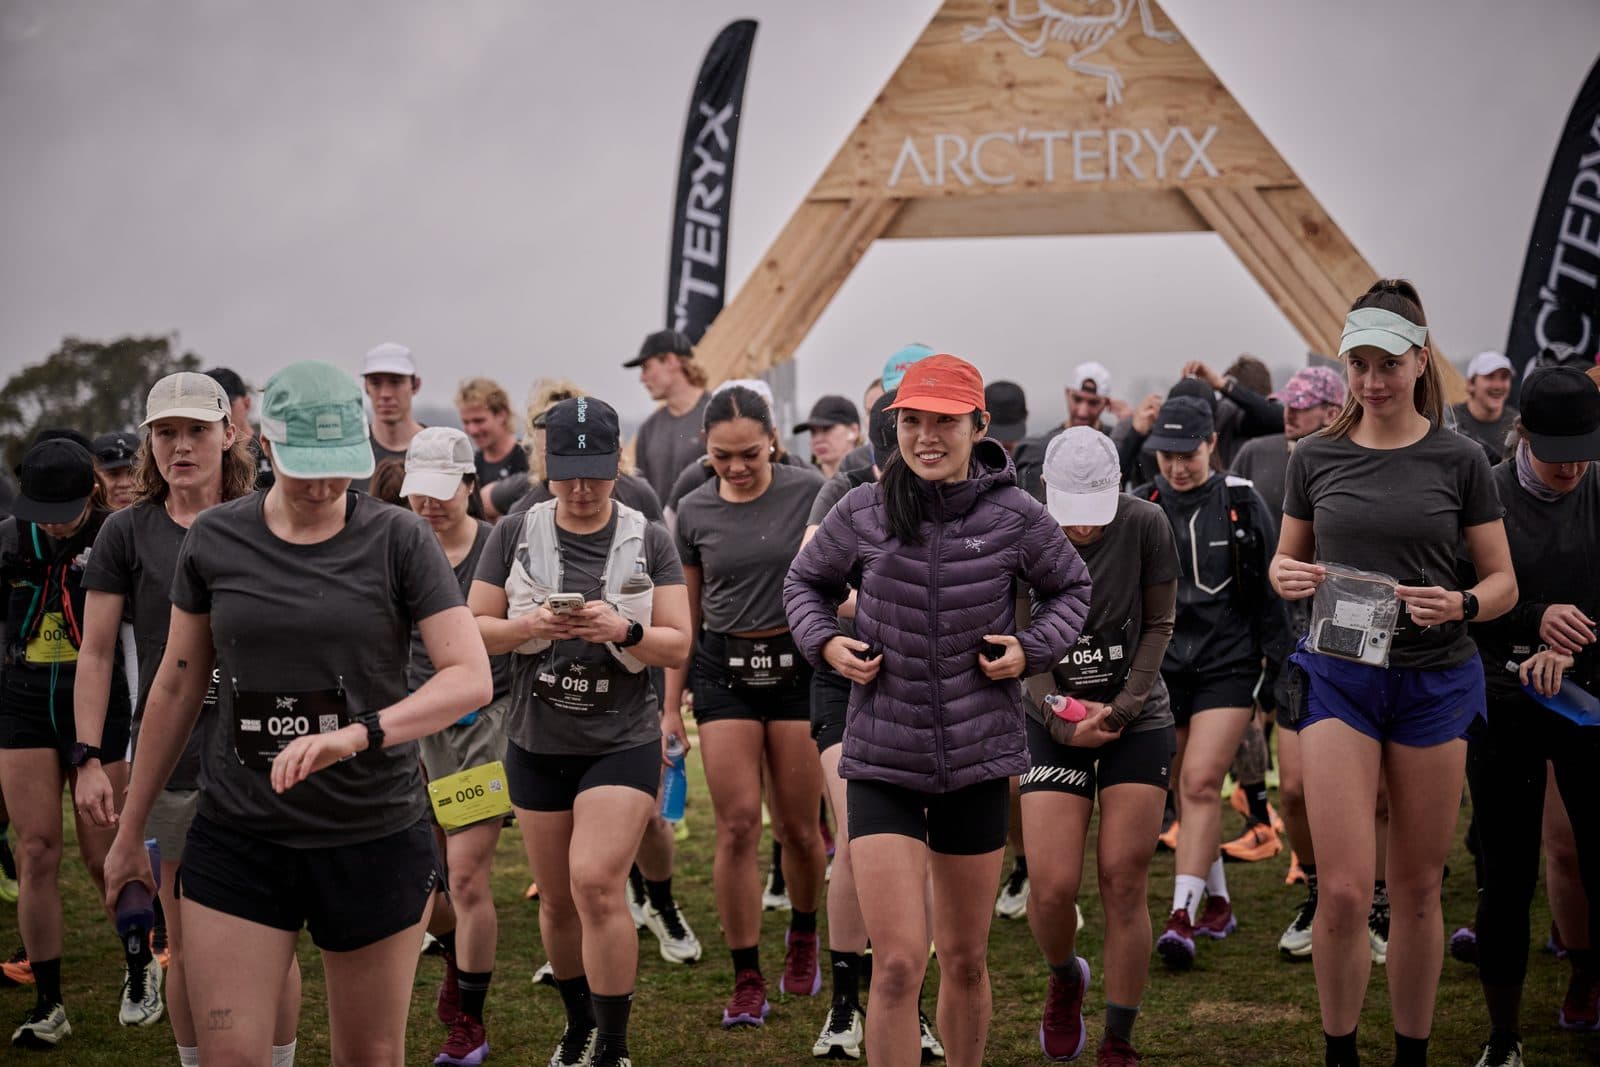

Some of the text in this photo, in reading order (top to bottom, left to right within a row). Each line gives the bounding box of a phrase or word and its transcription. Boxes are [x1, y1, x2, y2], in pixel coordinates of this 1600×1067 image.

[887, 126, 1220, 188] ARC'TERYX
[750, 655, 772, 669] 011
[1073, 648, 1103, 665] 054
[561, 676, 589, 693] 018
[267, 716, 310, 736] 020
[456, 785, 485, 803] 006
